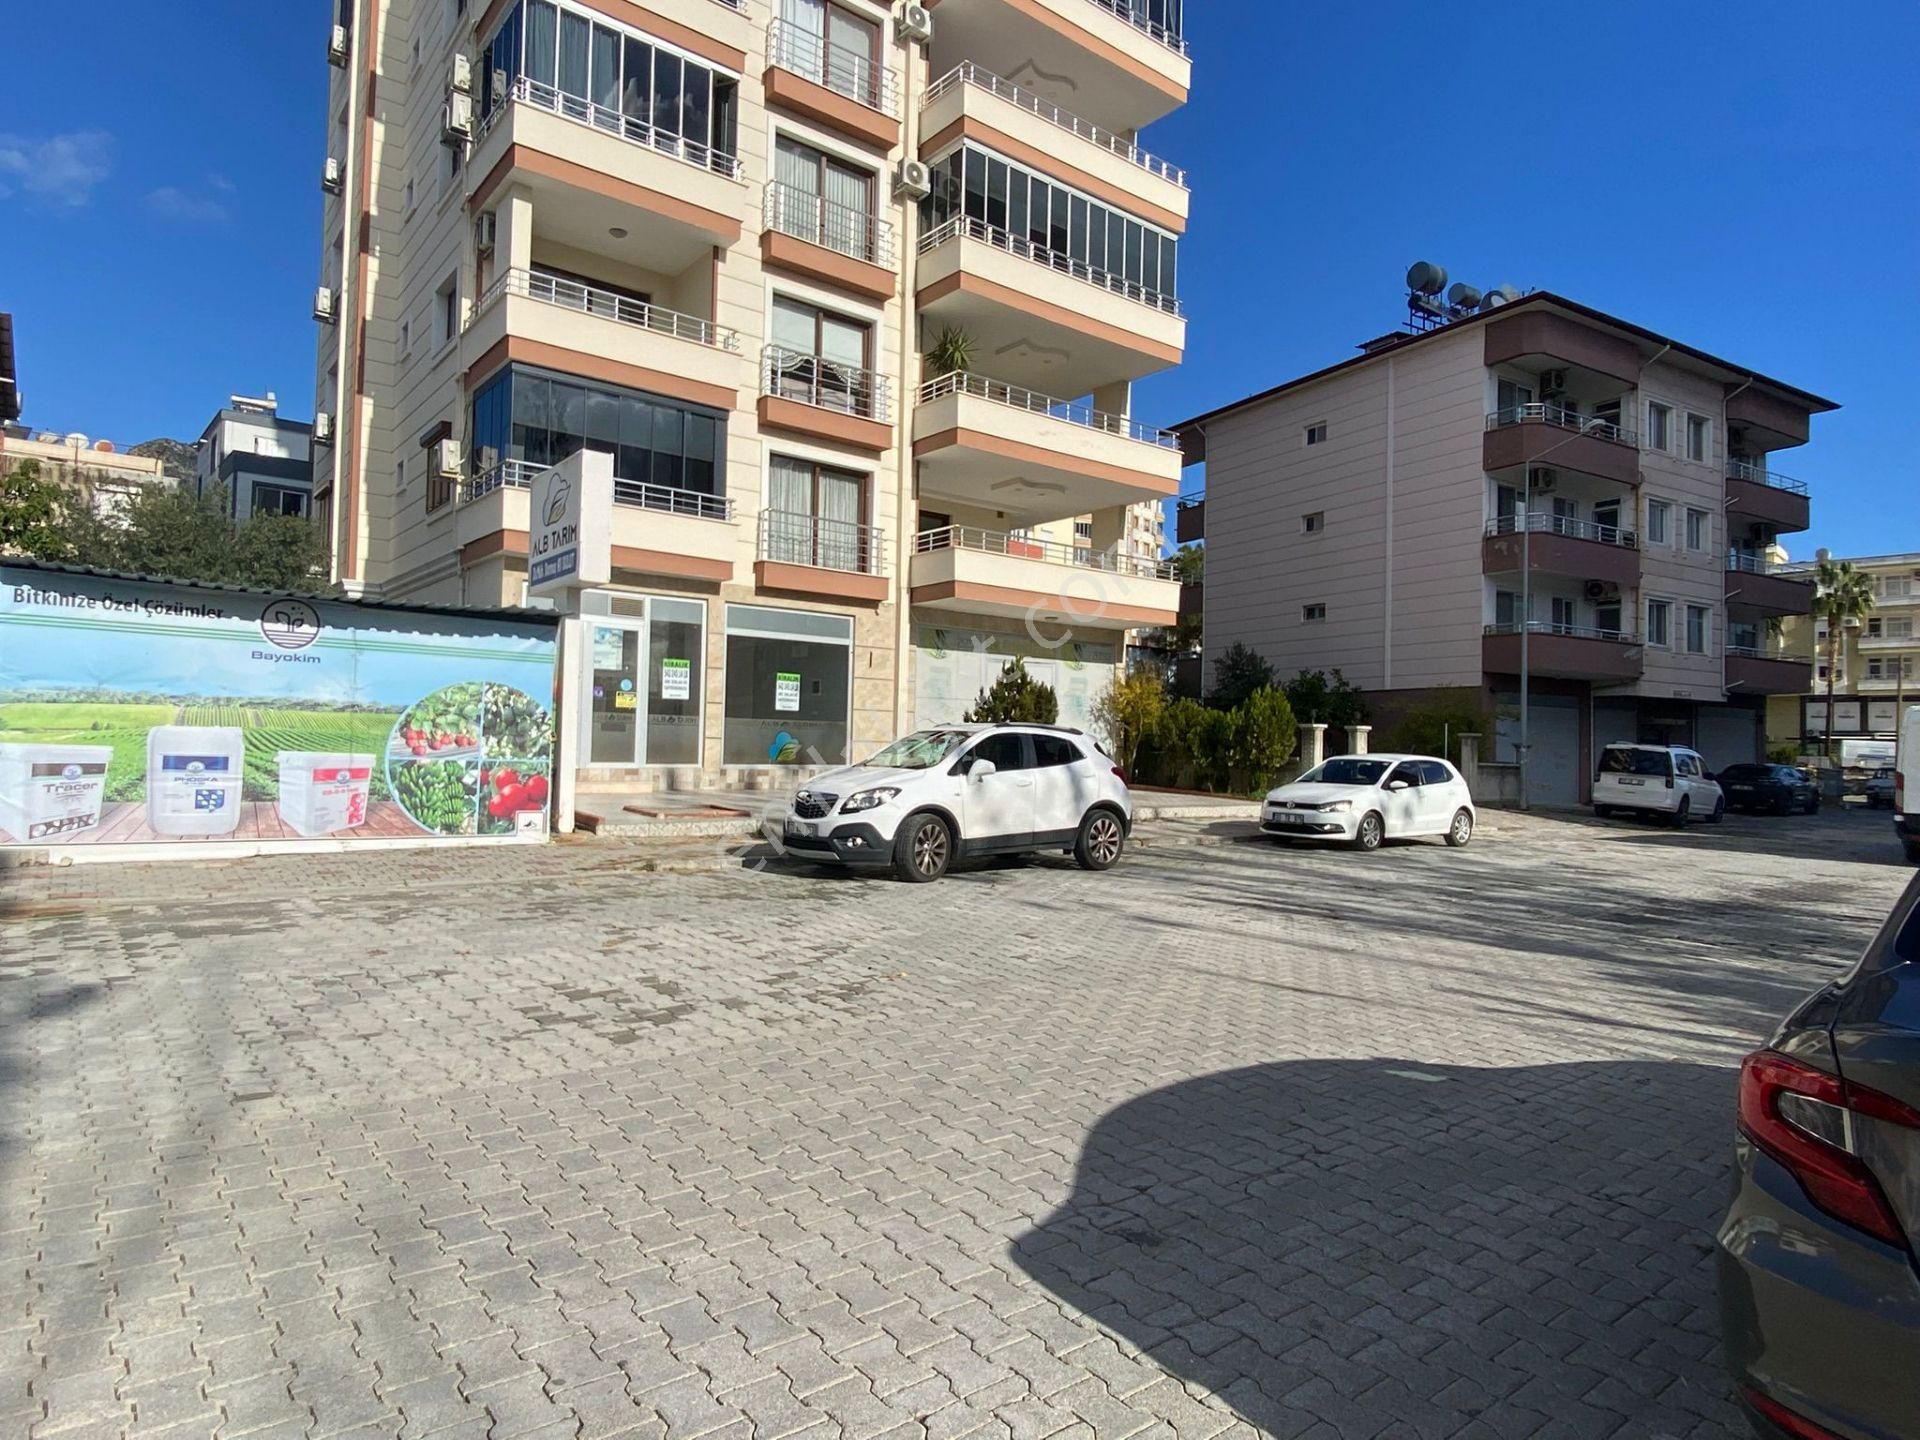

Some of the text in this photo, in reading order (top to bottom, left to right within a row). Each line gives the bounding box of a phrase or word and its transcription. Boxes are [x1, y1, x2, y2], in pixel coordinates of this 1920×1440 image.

[532, 524, 577, 557] ALB TARIM
[13, 588, 224, 619] Bitkinize Özel Çözümler
[251, 651, 321, 663] Bayokim
[42, 782, 98, 793] Tracer
